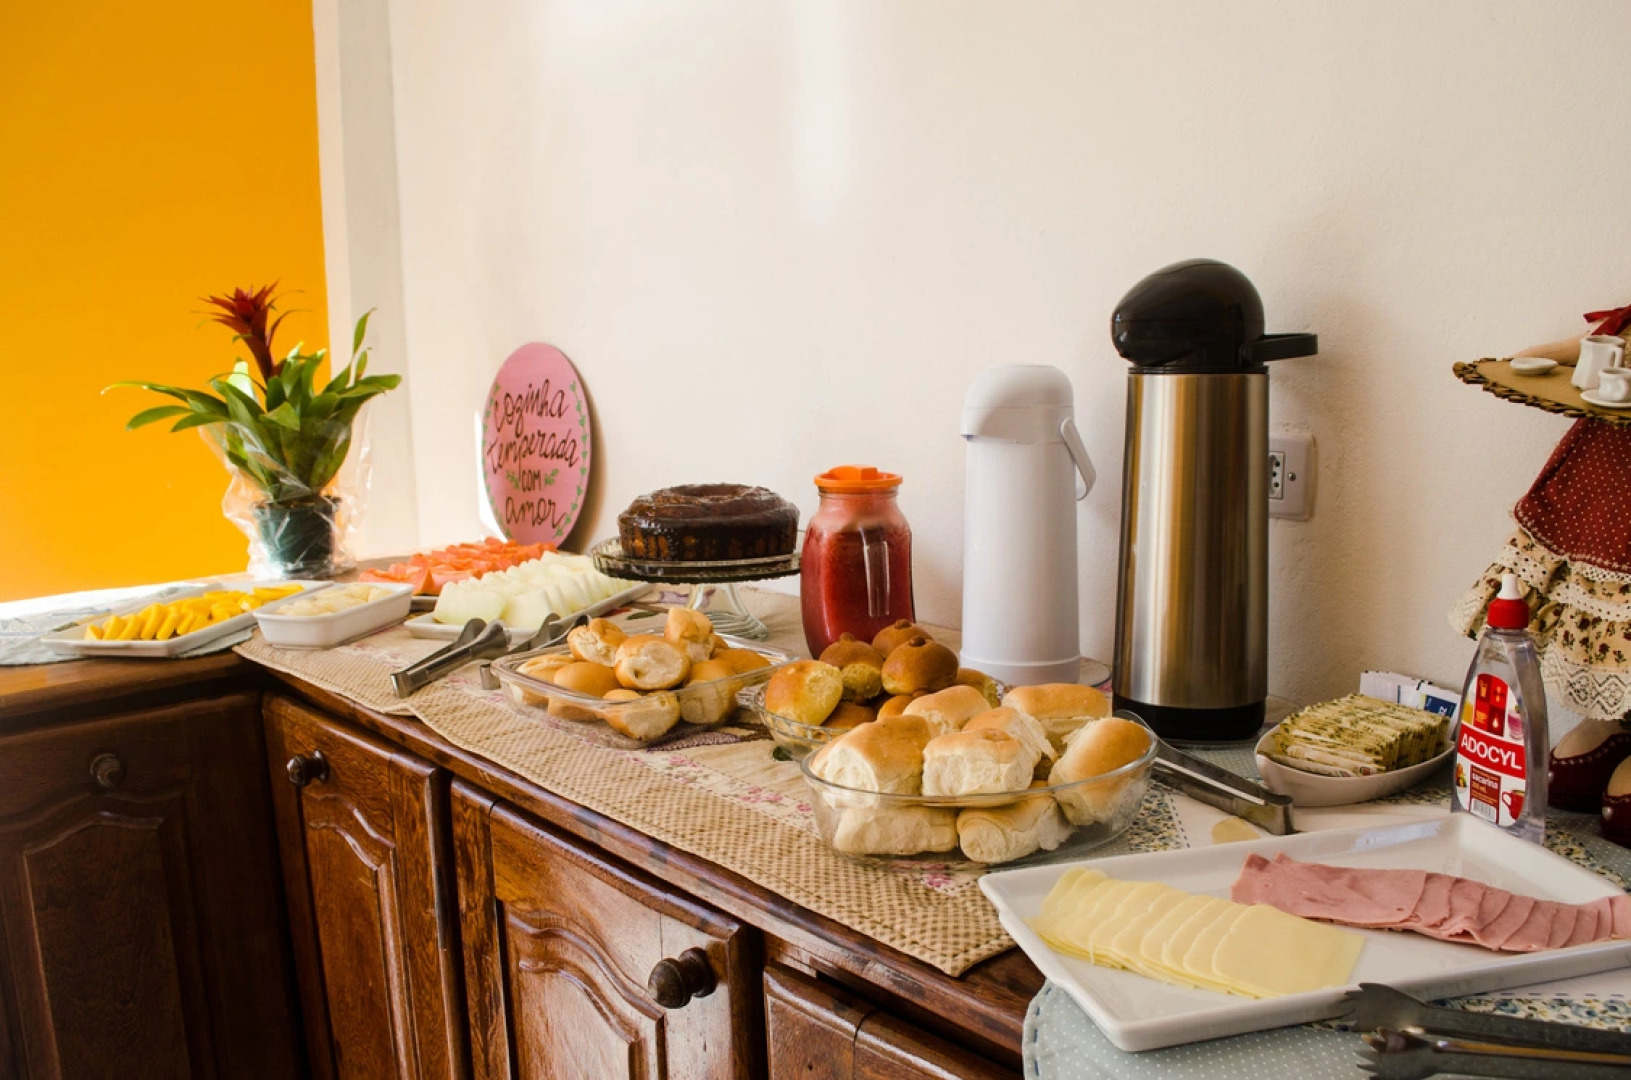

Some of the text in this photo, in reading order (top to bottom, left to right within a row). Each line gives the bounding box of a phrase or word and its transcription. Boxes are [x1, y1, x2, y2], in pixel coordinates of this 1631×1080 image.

[521, 467, 542, 492] com
[505, 496, 566, 529] amor
[1461, 733, 1523, 771] ADOCYL
